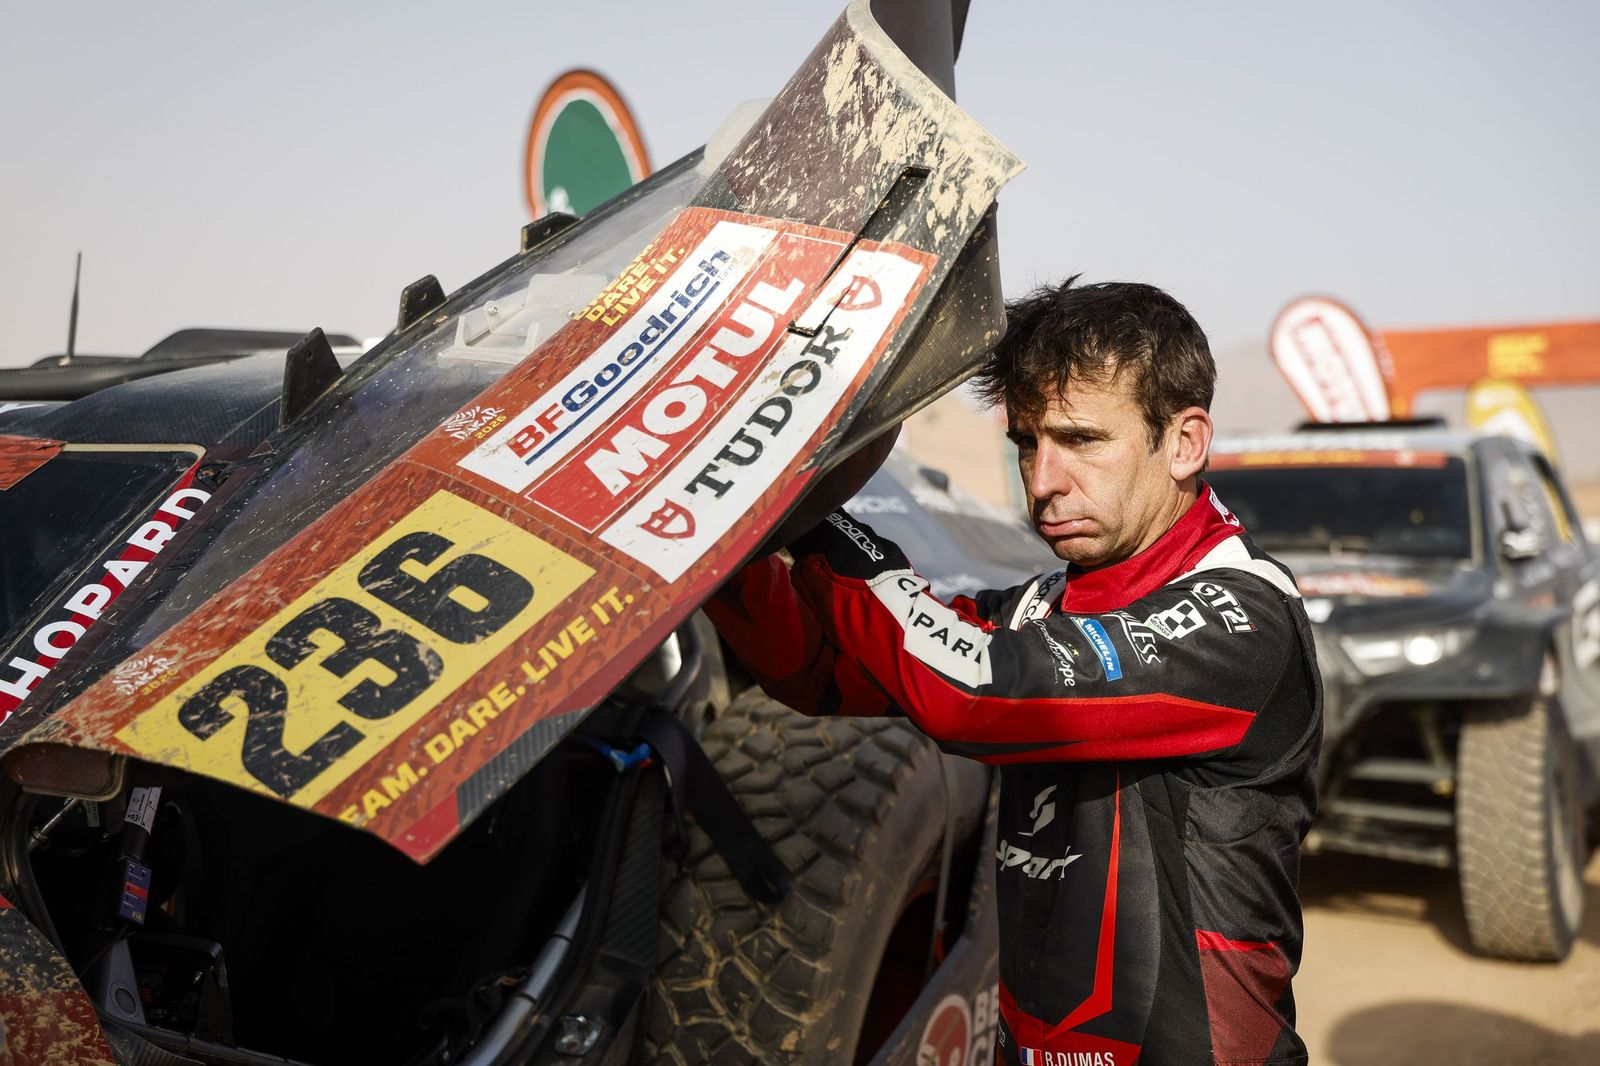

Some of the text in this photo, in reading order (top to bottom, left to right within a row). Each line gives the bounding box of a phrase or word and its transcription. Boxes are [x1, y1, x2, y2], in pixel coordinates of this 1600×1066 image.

[506, 250, 734, 459] BFGoodrich
[585, 258, 656, 322] DARE.
[601, 247, 685, 327] LIVE IT.
[474, 415, 507, 440] 2026
[584, 277, 805, 497] MOTUL
[684, 325, 854, 499] TUDOR
[0, 487, 212, 727] HOPARD
[826, 512, 884, 562] sparco
[177, 531, 535, 799] 236
[424, 682, 527, 765] DARE.
[521, 616, 596, 684] LIVE
[591, 586, 634, 626] IT.
[1084, 622, 1115, 672] MICHELIN
